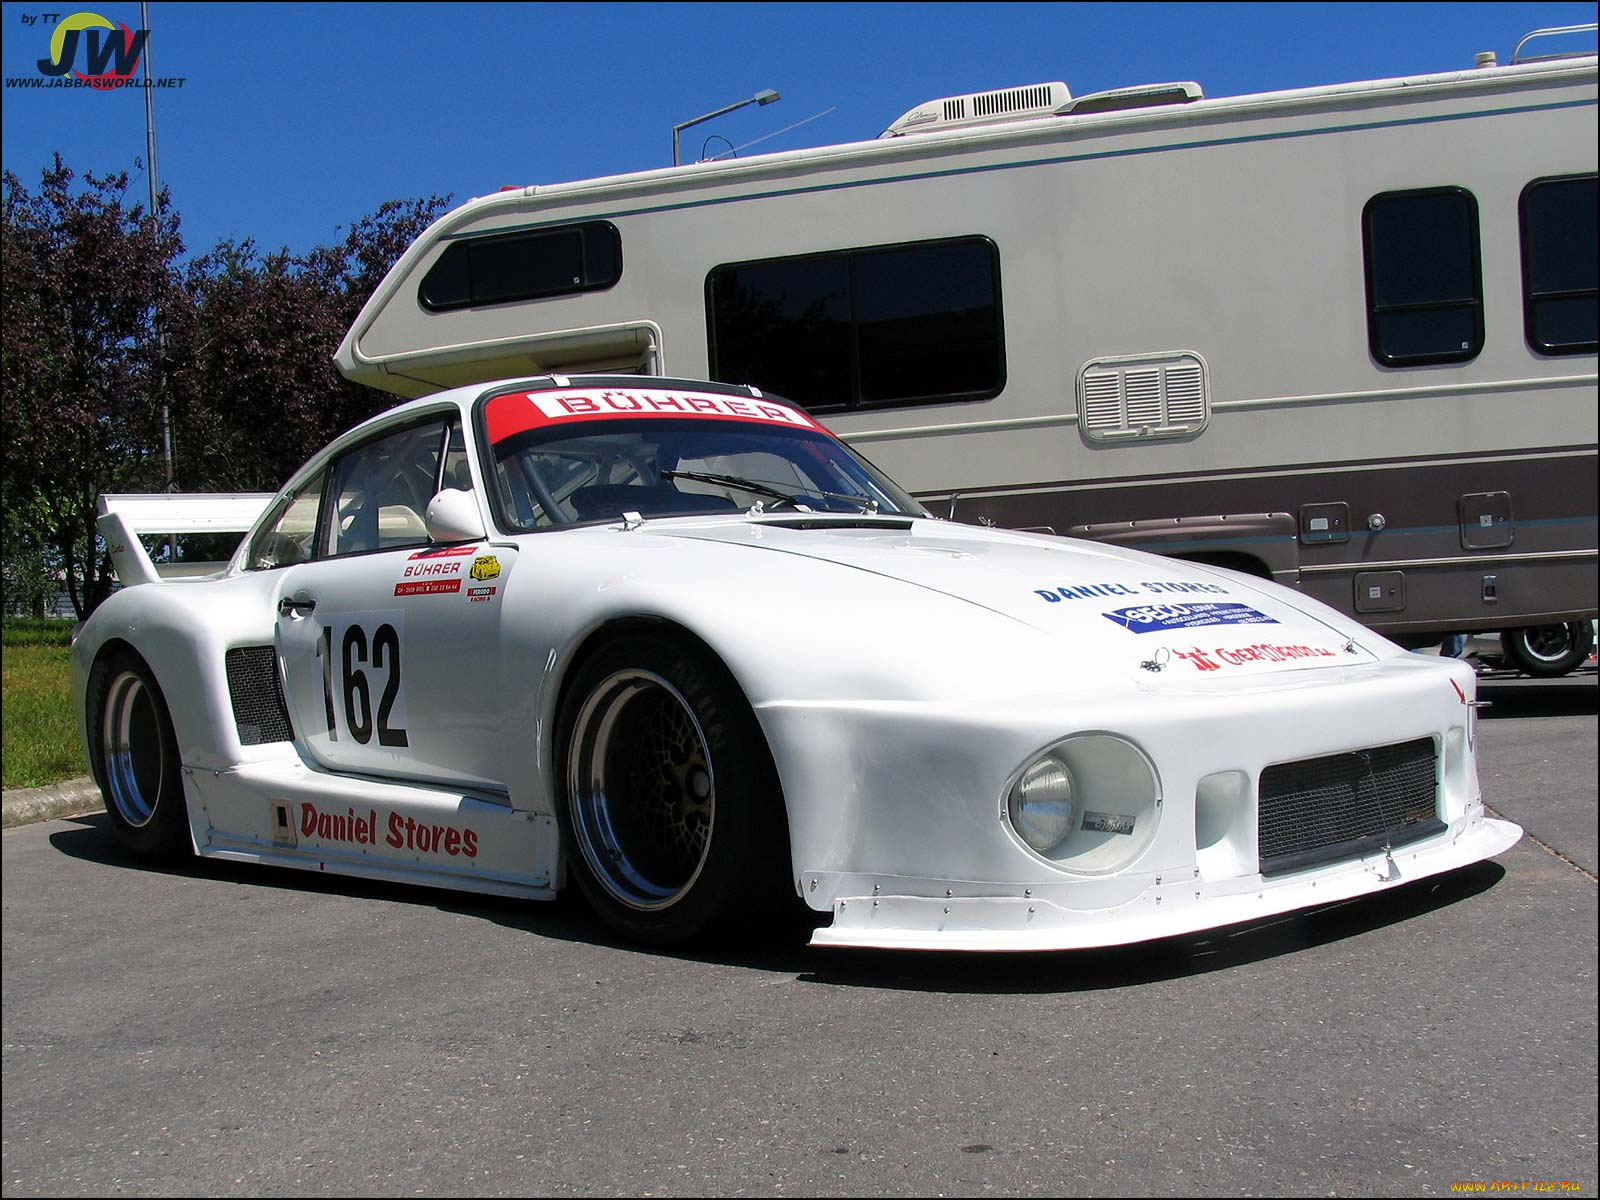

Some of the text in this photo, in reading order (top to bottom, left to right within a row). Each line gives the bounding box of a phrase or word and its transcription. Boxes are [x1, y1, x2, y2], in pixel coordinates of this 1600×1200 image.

[555, 390, 794, 422] BÜHRER
[403, 562, 462, 577] BÜHRER
[1033, 581, 1230, 604] DANIEL STORES
[316, 623, 409, 748] 162
[300, 802, 479, 858] Daniel Stores
